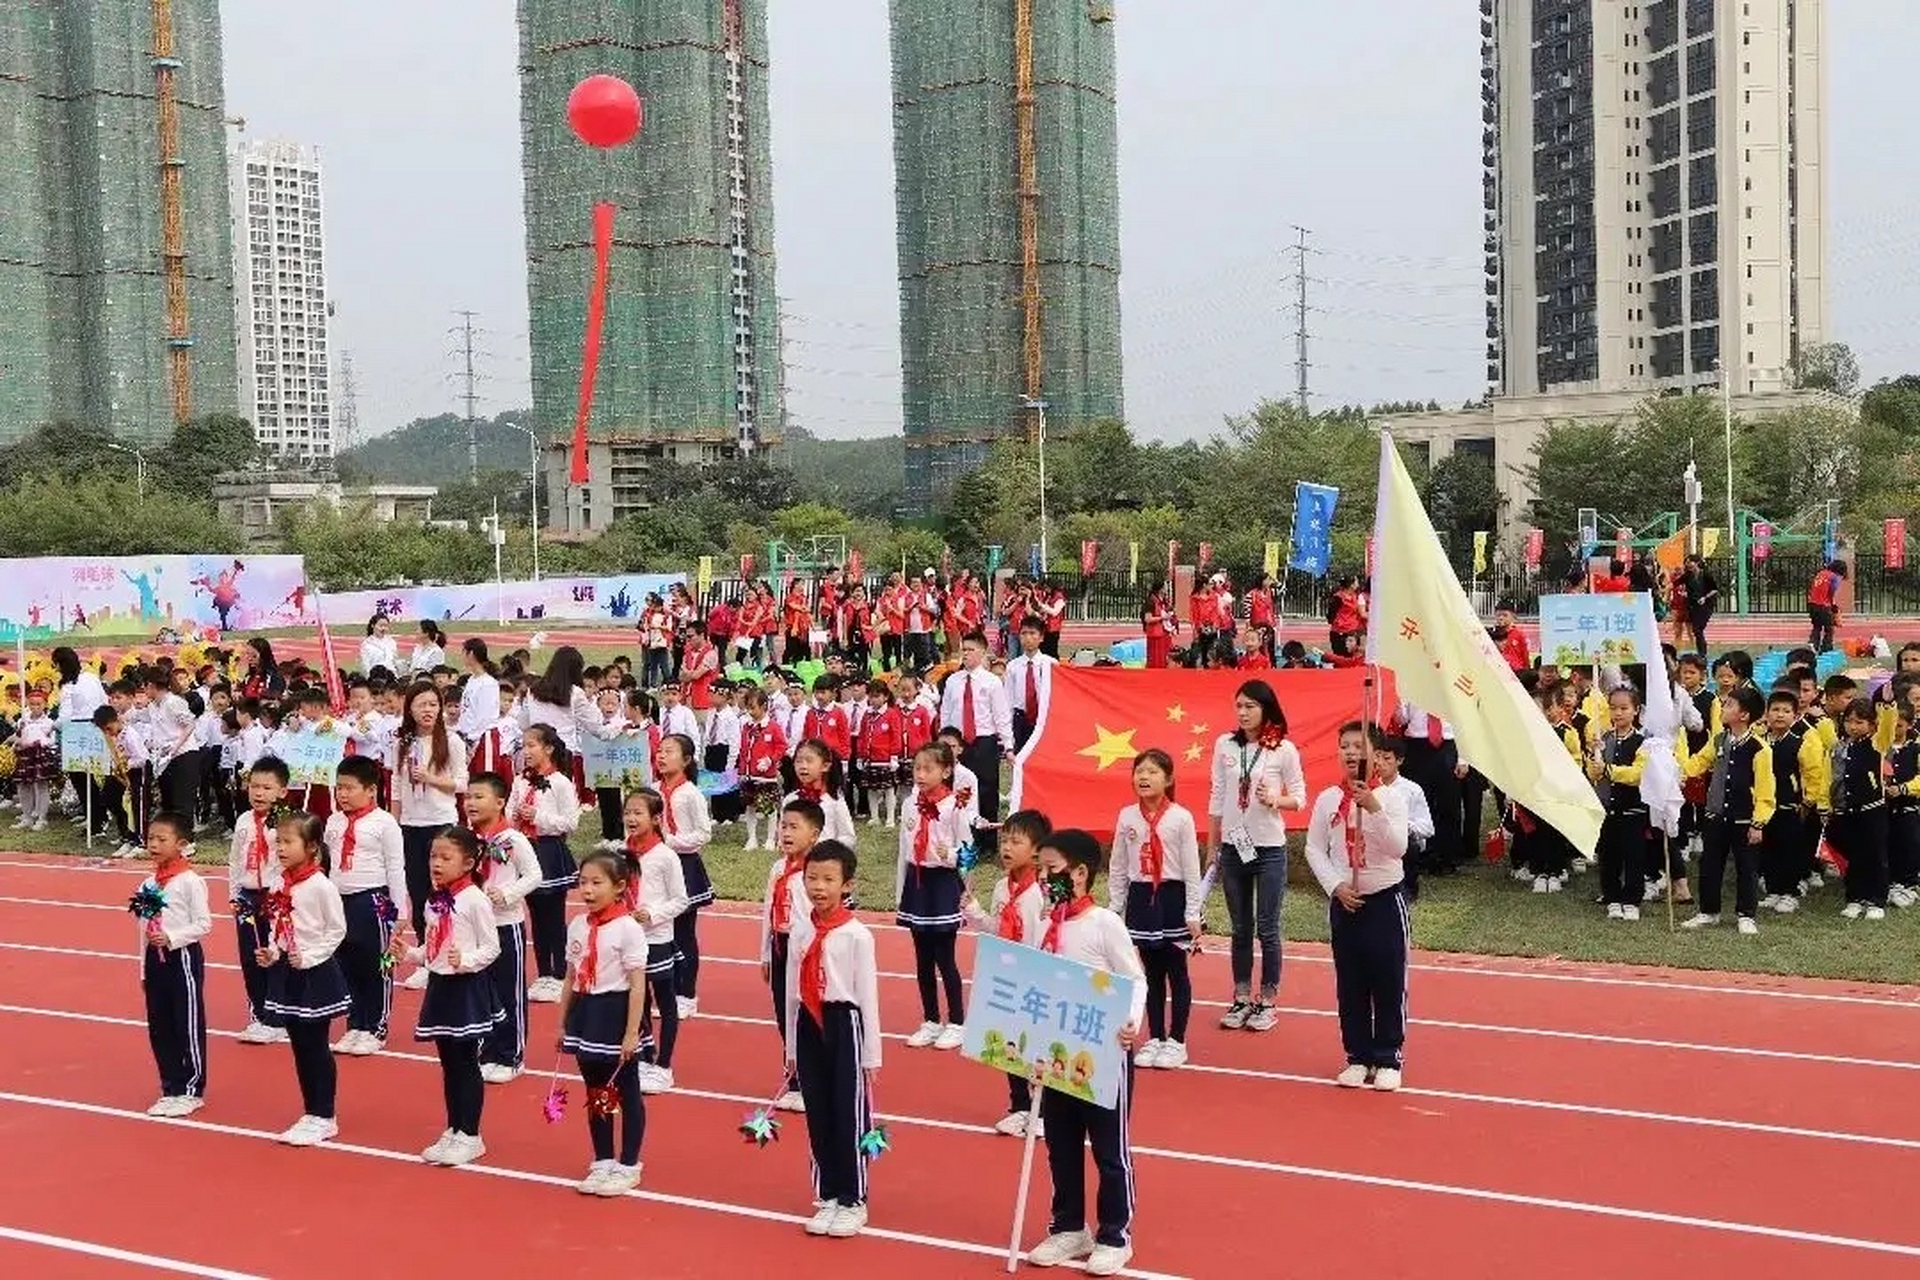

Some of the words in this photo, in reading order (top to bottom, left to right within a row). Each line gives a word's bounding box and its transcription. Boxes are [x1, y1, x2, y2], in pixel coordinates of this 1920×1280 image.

[1553, 612, 1636, 635] 二年1班
[986, 975, 1107, 1045] 三年1班
